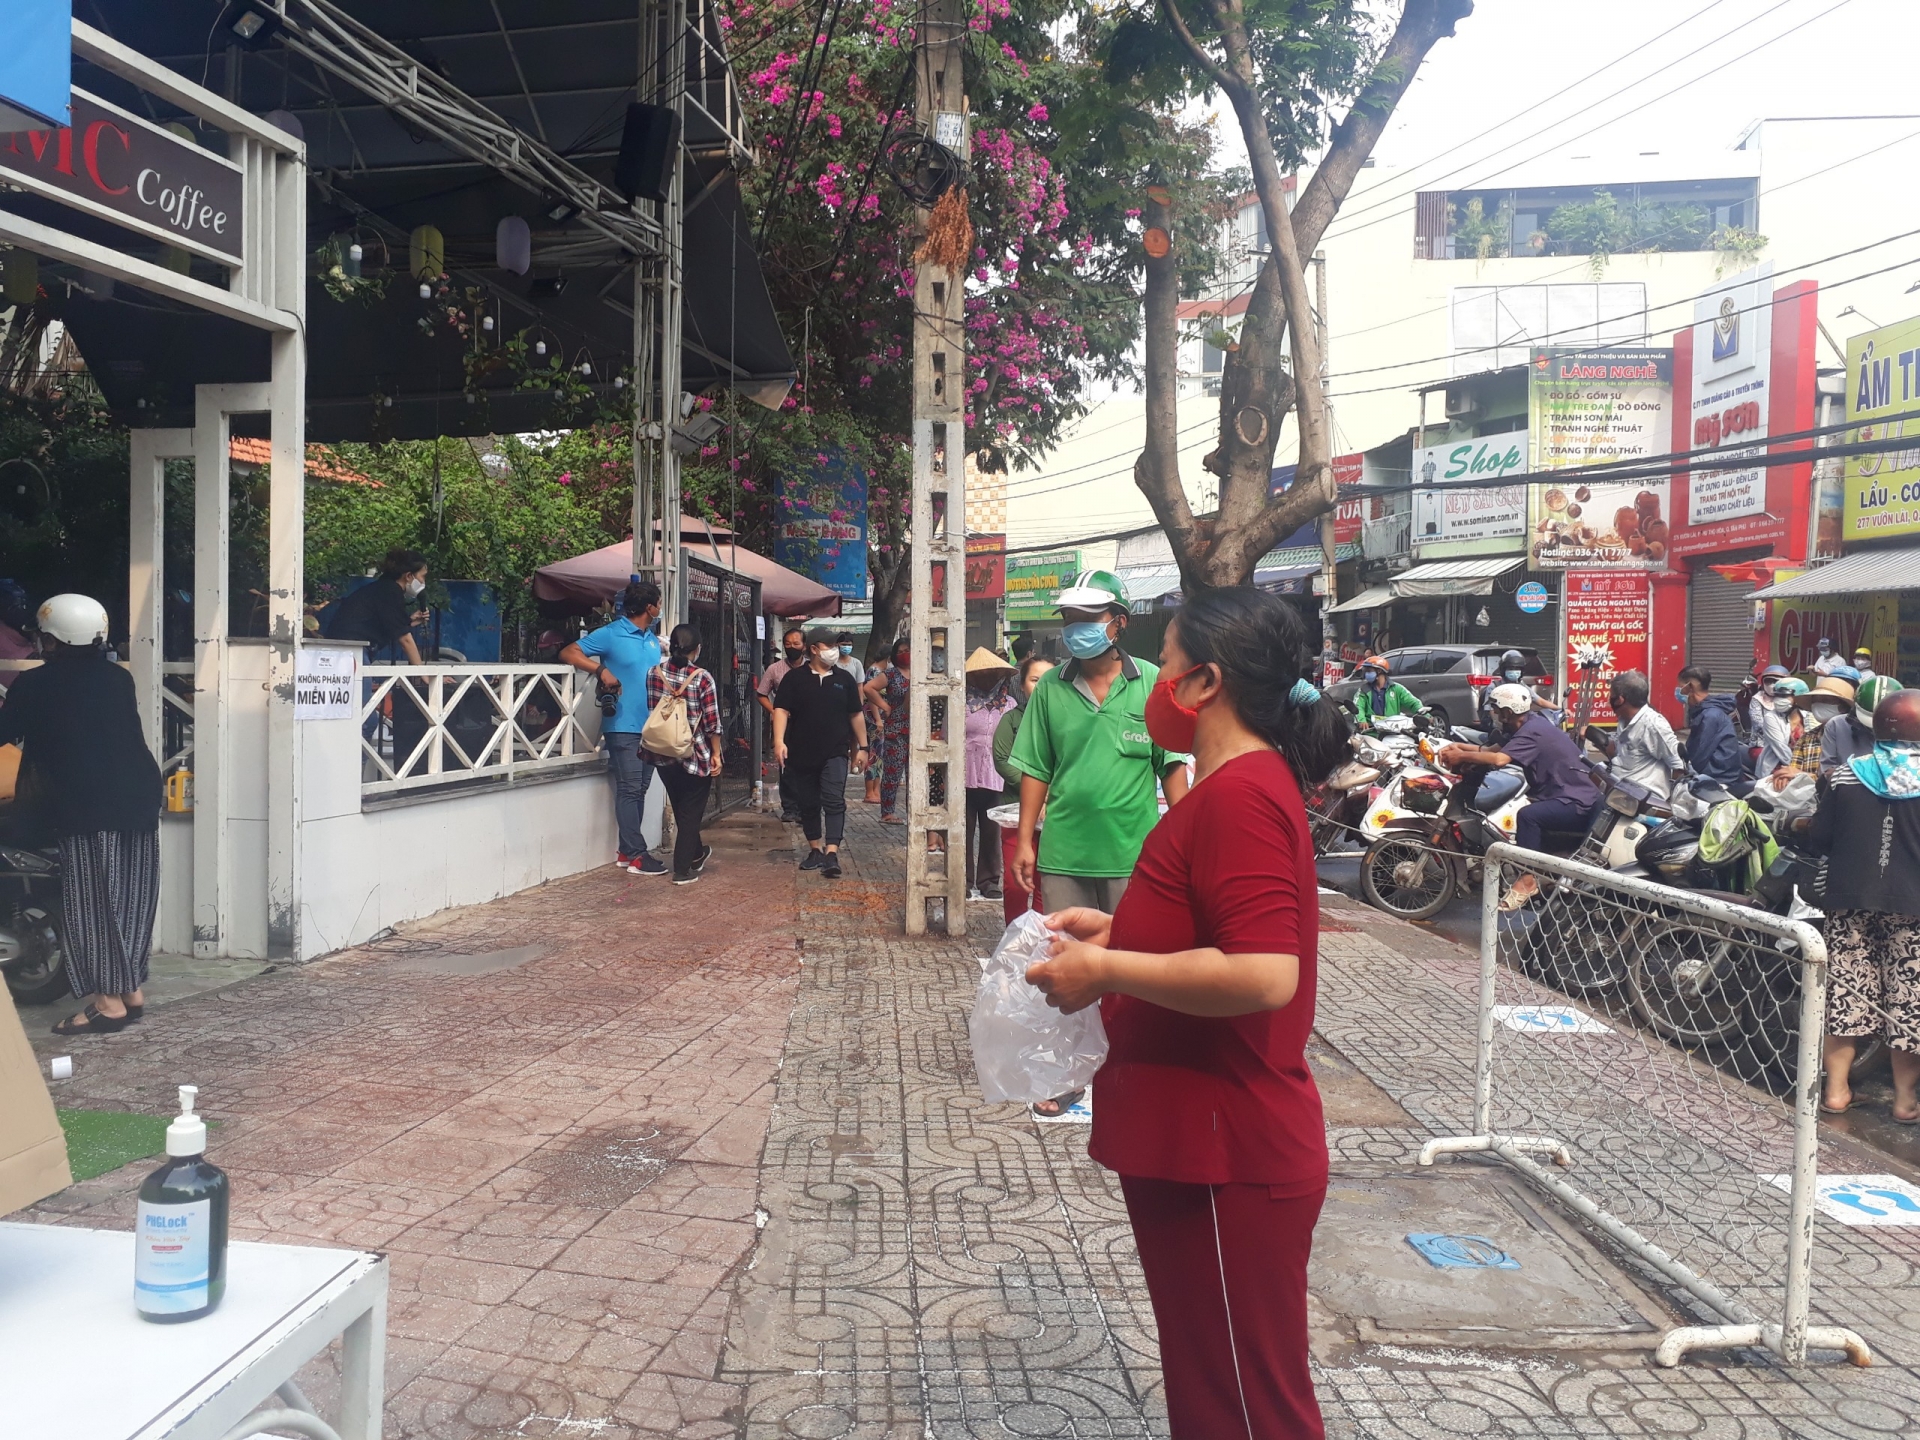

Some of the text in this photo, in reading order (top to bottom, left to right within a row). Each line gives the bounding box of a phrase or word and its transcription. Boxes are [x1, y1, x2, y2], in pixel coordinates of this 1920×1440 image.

[137, 168, 228, 235] Coffee
[1560, 359, 1657, 379] LÀNG NGHỀ
[1856, 340, 1891, 414] ẨM
[1550, 425, 1581, 433] TRANH
[1612, 424, 1643, 435] THUẬT
[1619, 444, 1643, 454] THẤT
[1444, 443, 1522, 478] Shop
[1860, 480, 1889, 509] LẨU
[1857, 516, 1870, 529] 277
[1871, 511, 1894, 527] VƯỜN
[1540, 548, 1574, 557] Hotline:
[1568, 598, 1592, 607] QUẢNG
[1593, 598, 1608, 606] CÁO
[1609, 598, 1631, 606] NGOÀI
[1572, 619, 1644, 631] NỘI THẤT GIÁ GỐC
[1589, 630, 1609, 642] GHẾ
[1614, 630, 1626, 642] TỦ
[1627, 632, 1647, 642] THỜ
[297, 673, 351, 686] KHÔNG PHẬN SỰ
[297, 686, 350, 705] MIỄN VÀO
[1122, 730, 1150, 744] Grab
